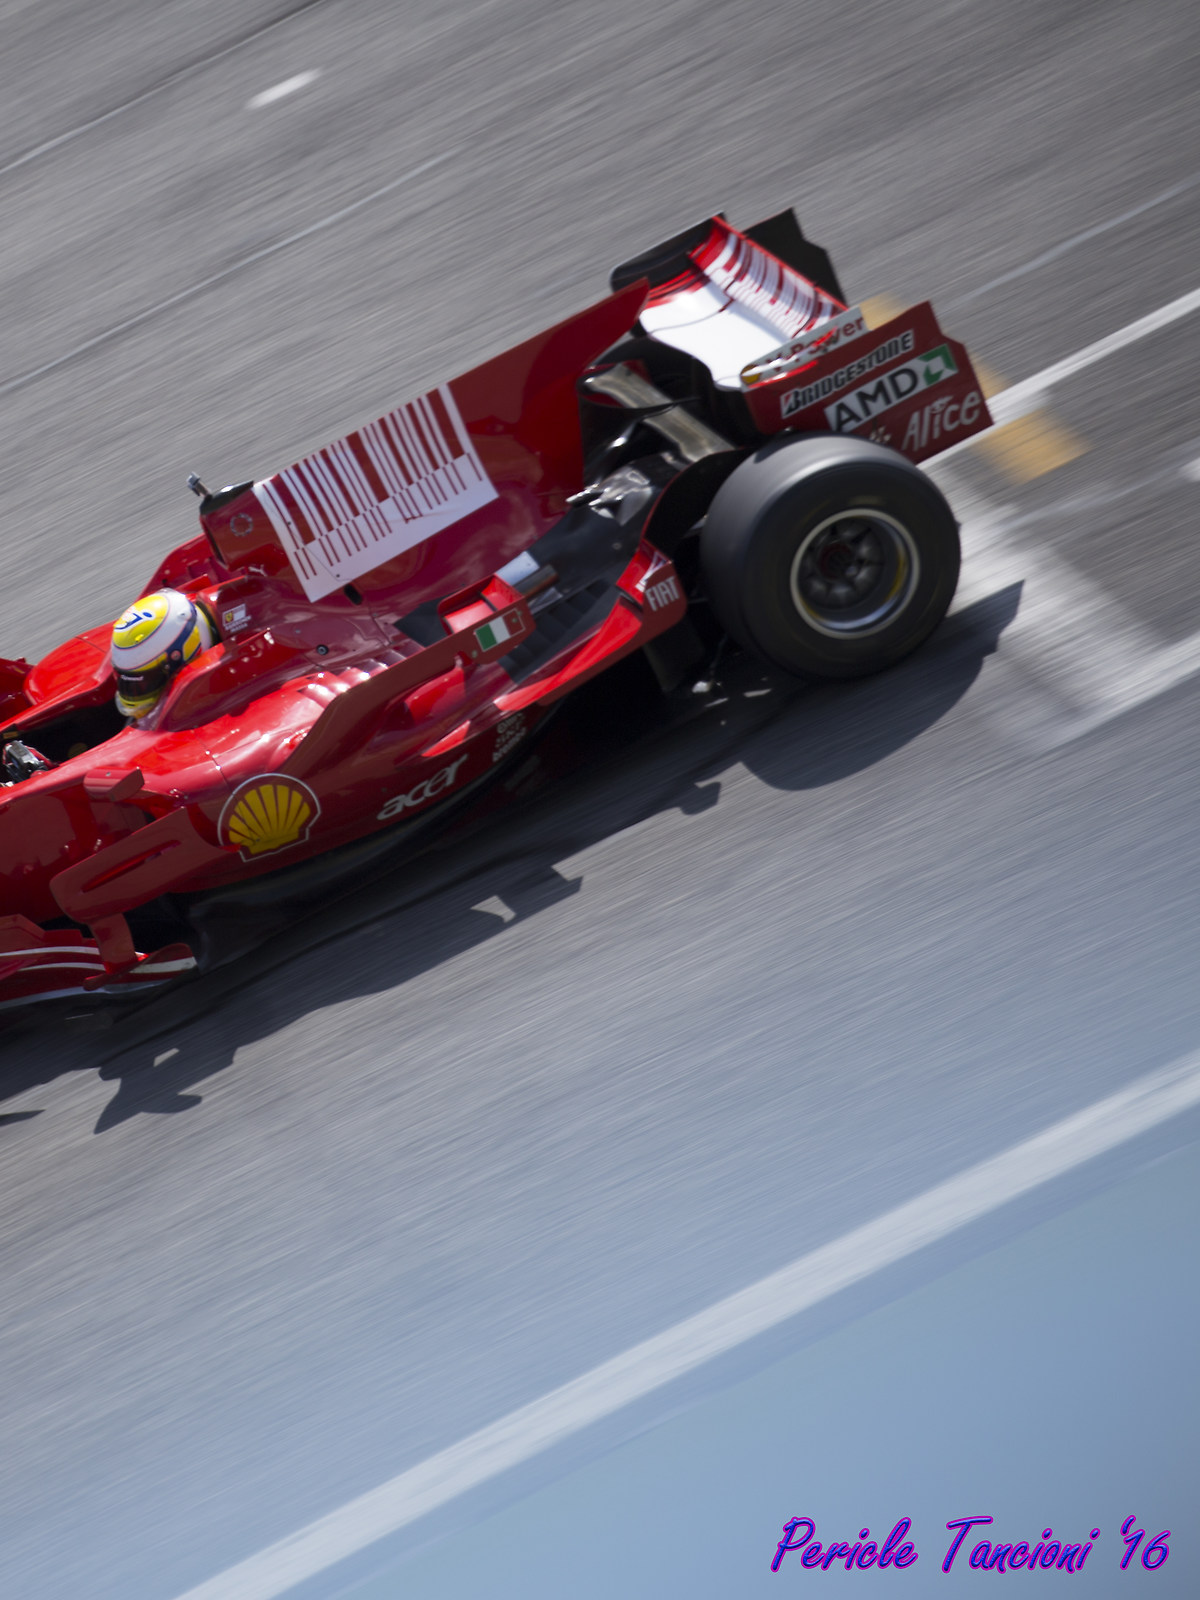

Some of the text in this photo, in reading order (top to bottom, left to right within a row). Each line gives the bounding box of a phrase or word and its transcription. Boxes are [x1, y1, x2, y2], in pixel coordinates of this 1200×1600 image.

[781, 329, 914, 418] BRIDGESTONE
[834, 368, 918, 431] AMD
[902, 390, 981, 451] Alice
[645, 576, 679, 611] FIAT
[377, 753, 468, 820] acer
